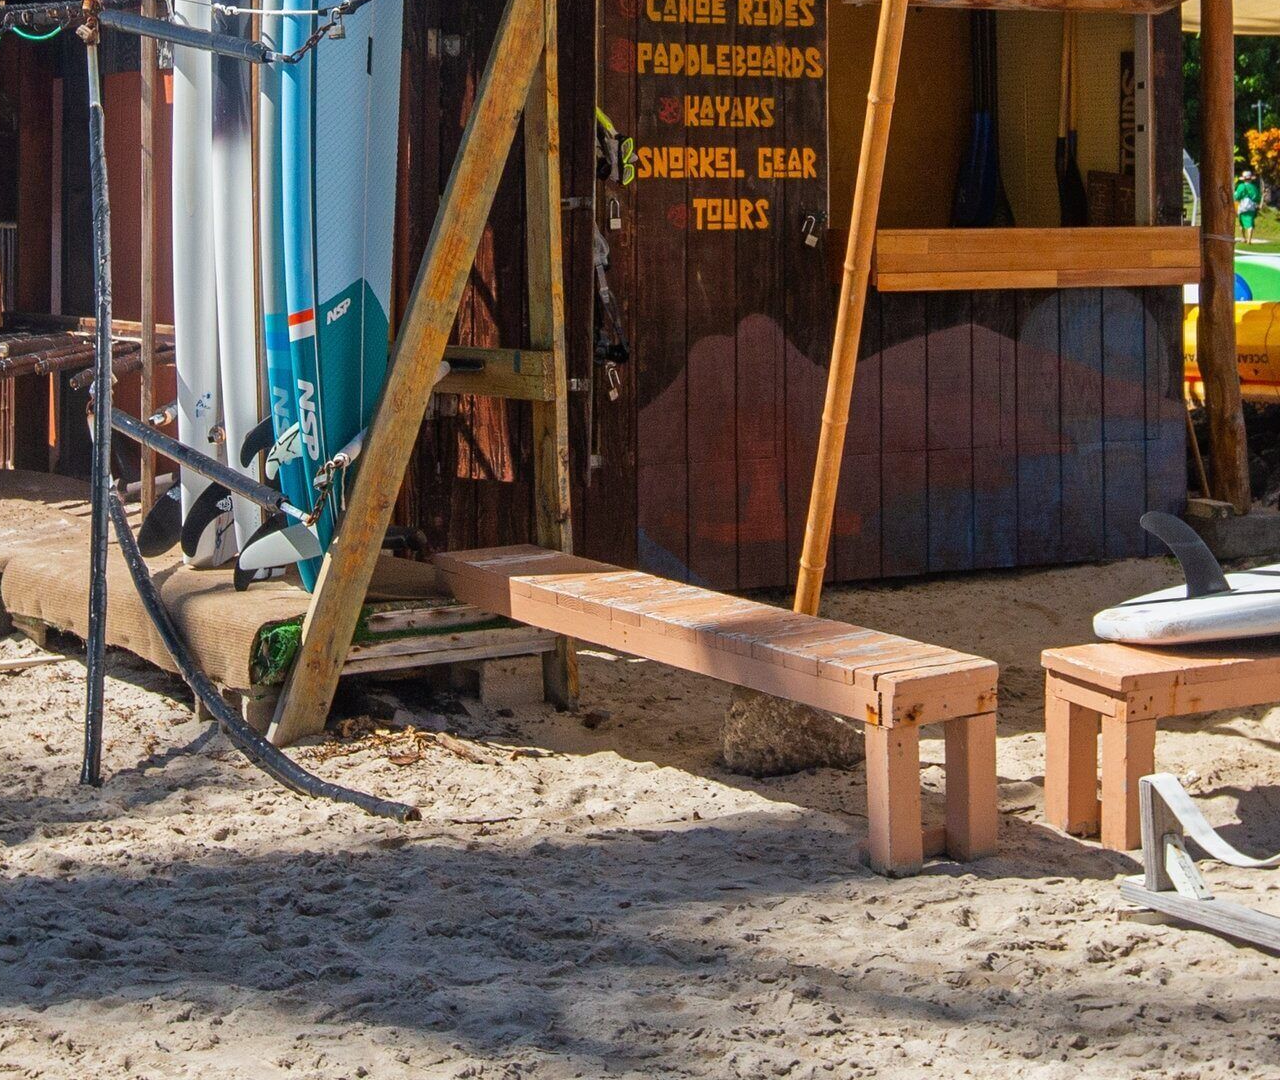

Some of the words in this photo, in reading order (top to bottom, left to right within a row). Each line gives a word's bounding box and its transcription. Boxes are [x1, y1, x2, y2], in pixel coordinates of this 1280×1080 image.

[637, 42, 824, 78] PADDLEBOARDS
[684, 96, 775, 127] KAYAKS
[637, 147, 745, 179] SNORKEL
[758, 147, 817, 179] GEAR
[693, 198, 769, 230] TOURS
[326, 297, 351, 326] NSP
[297, 379, 320, 461] NSP
